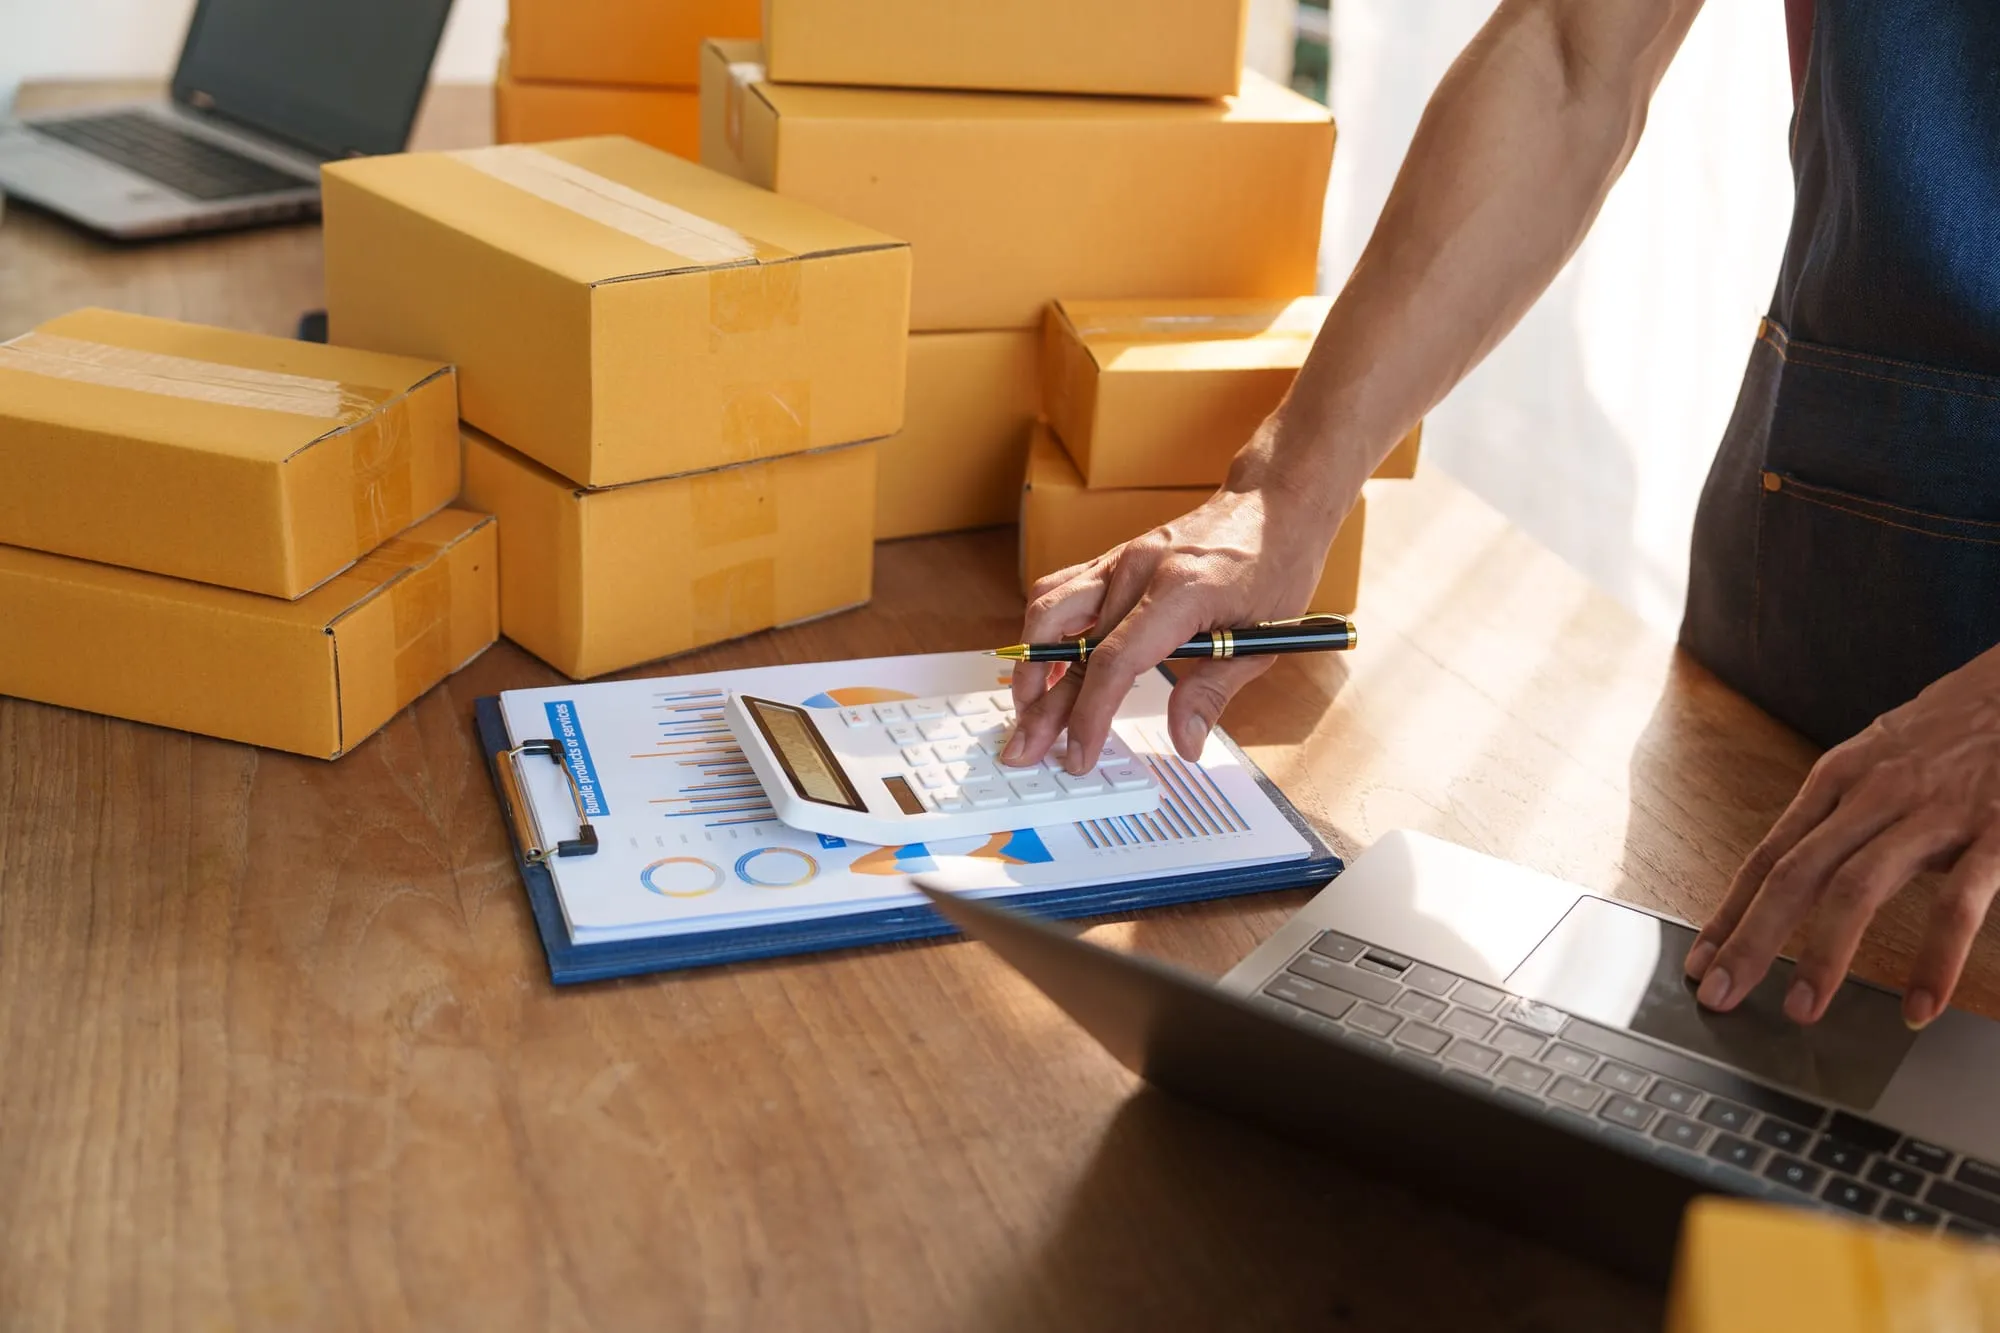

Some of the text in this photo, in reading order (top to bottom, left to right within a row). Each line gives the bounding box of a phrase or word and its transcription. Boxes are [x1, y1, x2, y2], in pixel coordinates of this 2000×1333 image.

[555, 703, 600, 814] Bundle products or services
